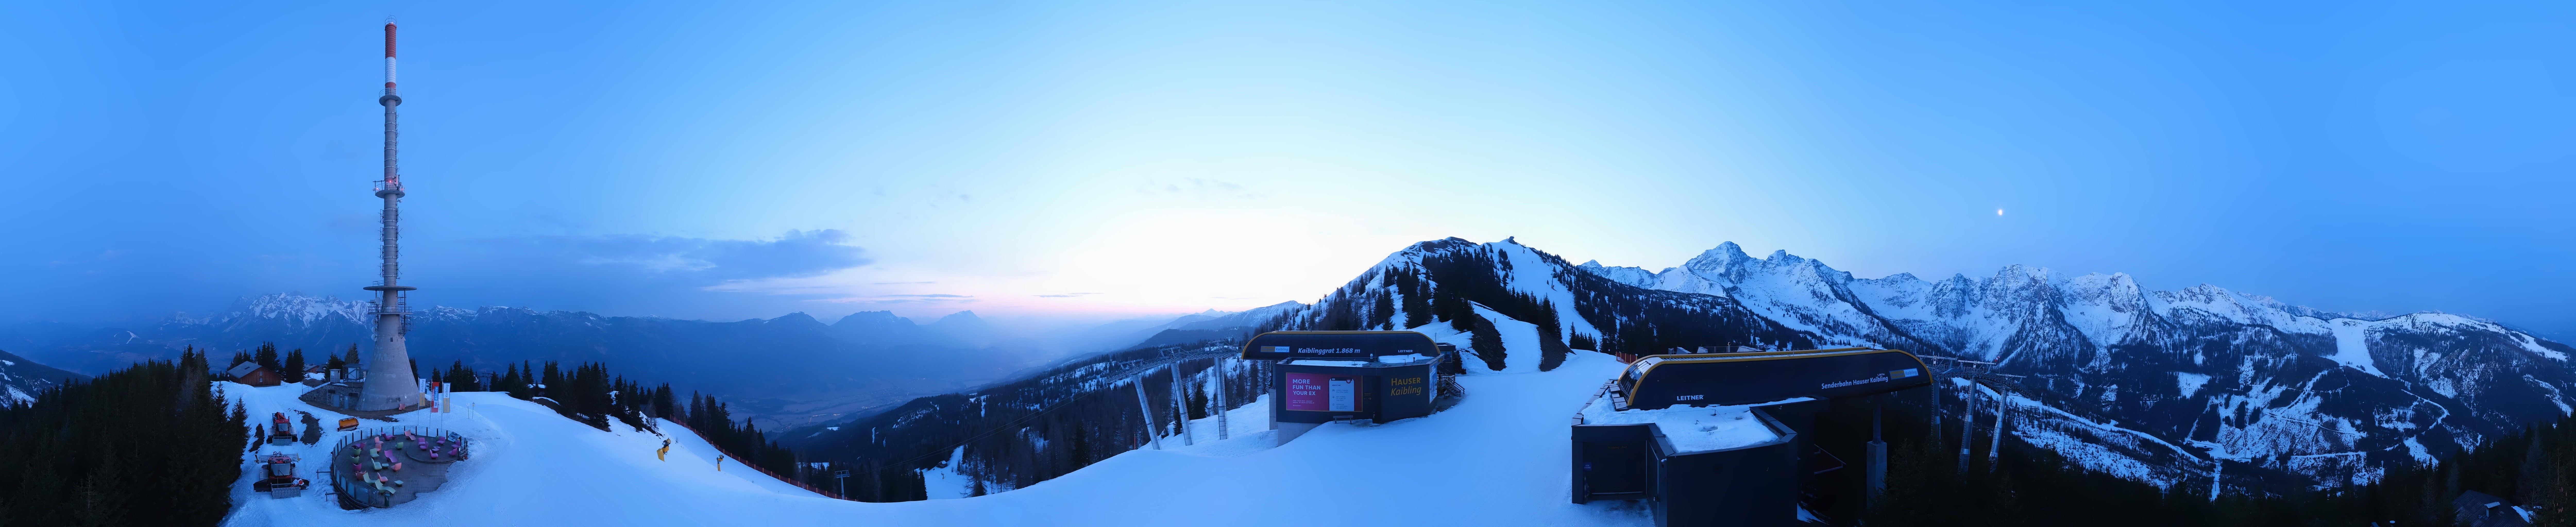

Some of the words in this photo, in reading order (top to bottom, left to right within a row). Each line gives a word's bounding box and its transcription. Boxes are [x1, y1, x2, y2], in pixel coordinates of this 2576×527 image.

[1391, 377, 1421, 386] HAUSER
[1821, 380, 1852, 389] Senderbahn
[1391, 386, 1421, 396] Kaibling
